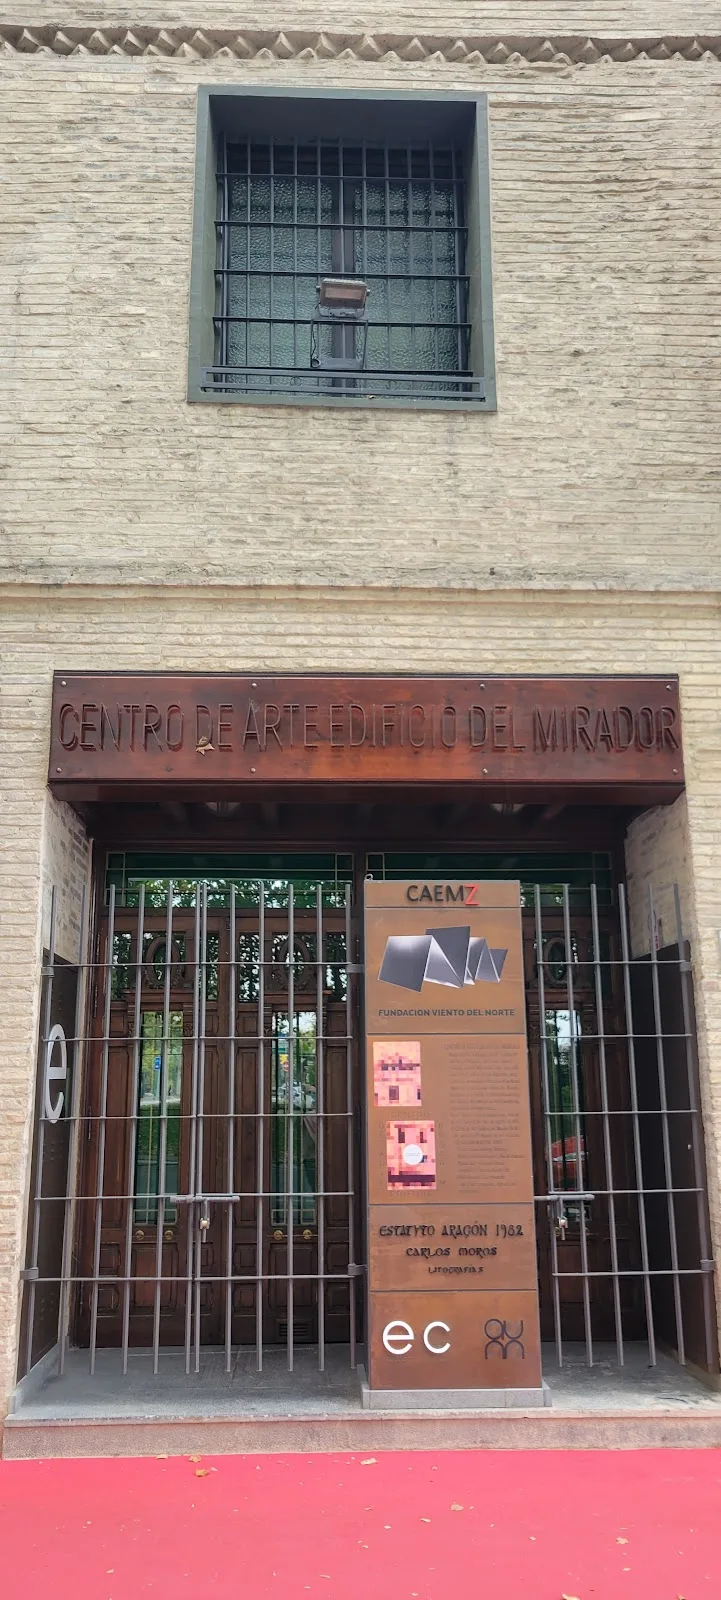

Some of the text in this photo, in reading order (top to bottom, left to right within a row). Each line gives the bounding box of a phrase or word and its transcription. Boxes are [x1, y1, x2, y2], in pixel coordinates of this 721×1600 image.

[58, 702, 680, 752] CENTRO DE ARTE EDIFICIO DEL MIRADOR
[406, 884, 481, 906] CAEMZ
[378, 1009, 431, 1017] FUNDACION
[432, 1009, 465, 1017] VIENTO
[466, 1009, 484, 1017] DEL
[441, 1220, 488, 1239] ARAGÓN
[496, 1223, 524, 1239] 1982
[406, 1247, 498, 1260] CARLOS MOROS
